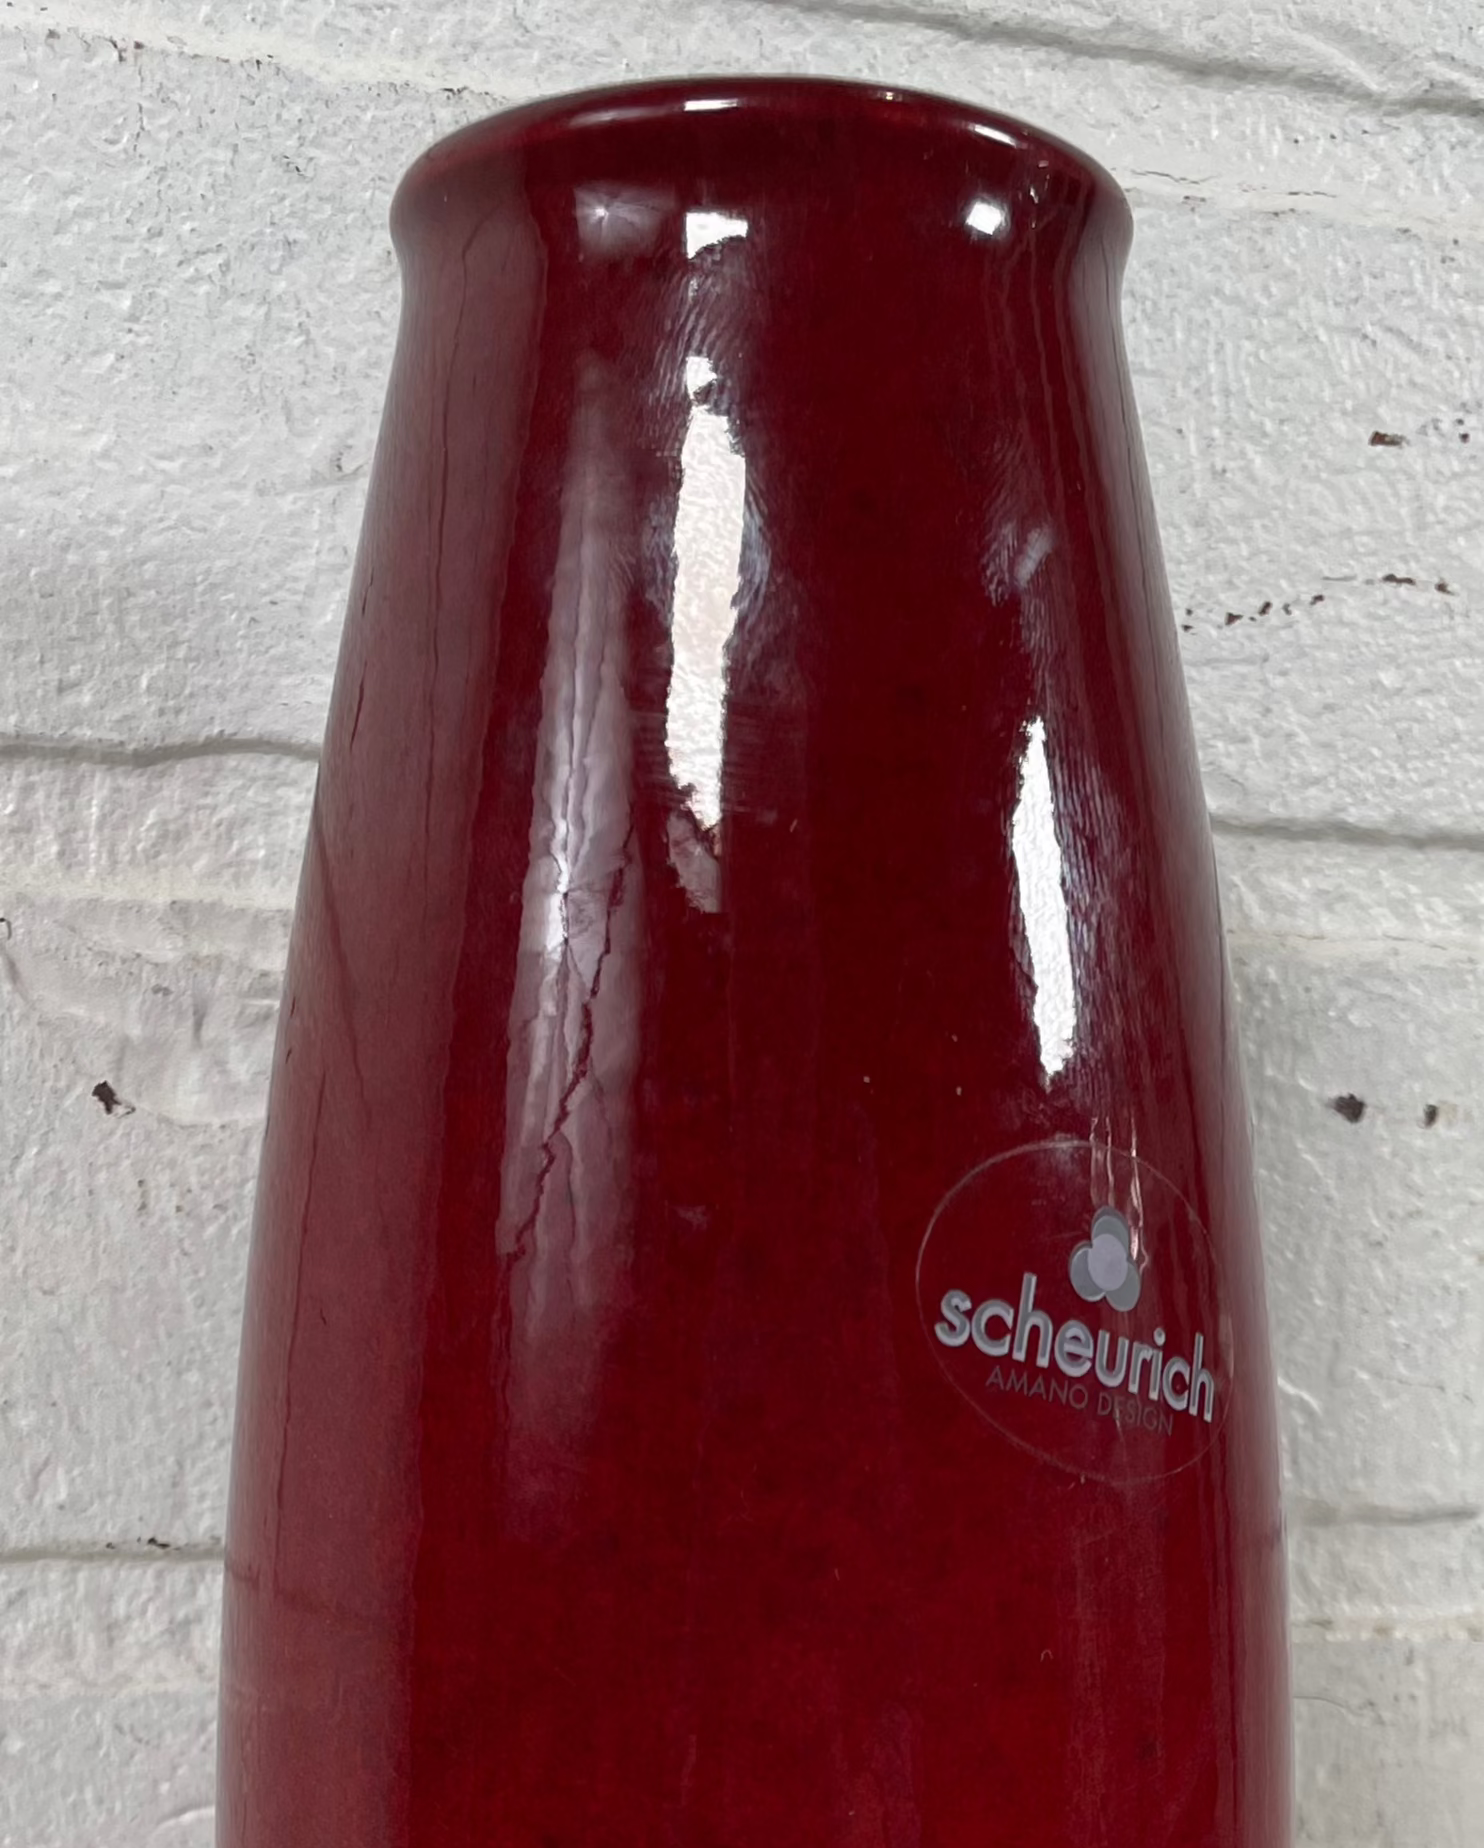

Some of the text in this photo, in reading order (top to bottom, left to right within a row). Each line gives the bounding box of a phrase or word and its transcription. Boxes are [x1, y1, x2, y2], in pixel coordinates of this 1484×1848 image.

[934, 1272, 1215, 1423] scheurich
[985, 1366, 1173, 1436] AMANO DESIGN
